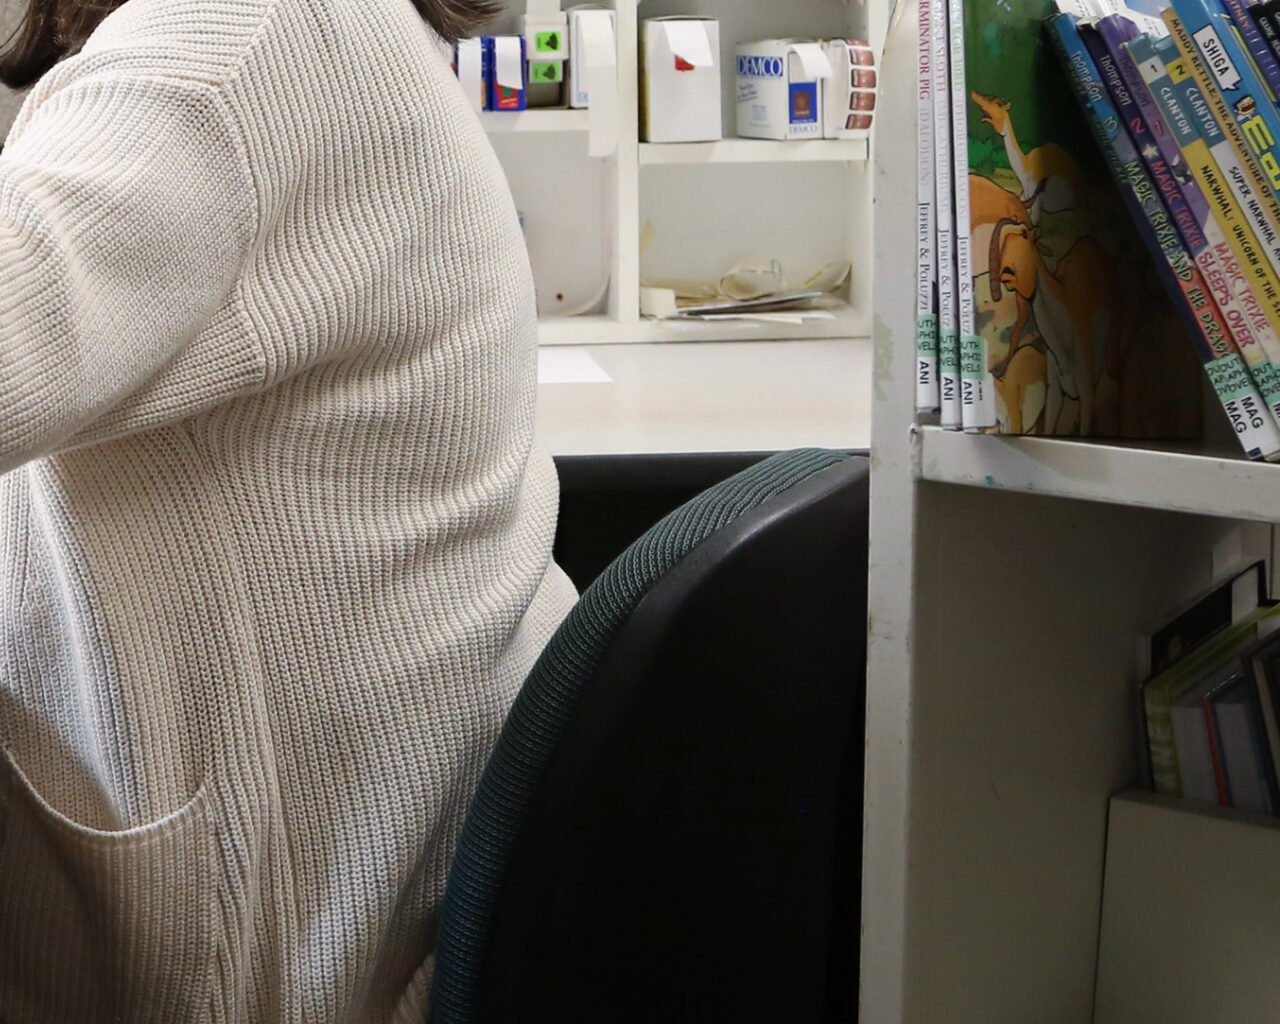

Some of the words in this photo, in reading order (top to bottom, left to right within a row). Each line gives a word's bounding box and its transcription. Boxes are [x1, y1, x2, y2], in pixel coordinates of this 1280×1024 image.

[737, 56, 782, 76] DEMCO
[1202, 38, 1231, 77] SHIGA
[919, 78, 931, 101] PIG
[1169, 18, 1196, 55] MADDY
[1214, 98, 1231, 122] THE
[1225, 121, 1263, 185] ADVENTURE
[1260, 184, 1274, 199] OF
[1175, 64, 1186, 76] 2
[1186, 86, 1220, 137] CLANTON
[1228, 165, 1253, 199] SUPER
[1247, 199, 1277, 246] NARWHAL
[1071, 50, 1103, 103] Thompson
[1104, 114, 1118, 133] 3
[1124, 159, 1157, 207] MAGIC
[1150, 207, 1178, 252] TRIXIE
[1168, 250, 1193, 282] AND
[1186, 284, 1210, 310] THE
[1150, 63, 1159, 74] 1
[1160, 86, 1193, 136] CLANTON
[1232, 224, 1260, 266] UNICORN
[1255, 267, 1266, 279] OF
[1262, 280, 1277, 298] THE
[1099, 55, 1132, 106] Thompson
[1131, 117, 1145, 134] 2
[1150, 160, 1182, 205] MAGIC
[1175, 205, 1204, 249] TRIXIE
[1196, 250, 1234, 307] SLEEPS
[1226, 309, 1256, 349] OVER
[918, 202, 930, 243] JEFFREY
[919, 247, 930, 259] &
[938, 228, 949, 269] JEFFREY
[957, 236, 969, 277] JEFFREY
[941, 275, 950, 286] &
[960, 282, 970, 294] &
[1213, 241, 1246, 289] MAGIC
[1238, 287, 1271, 333] TRIXIE
[919, 360, 929, 385] ANI
[943, 377, 954, 401] ANI
[963, 381, 974, 405] ANI
[1224, 400, 1248, 434] MAG
[1240, 396, 1264, 429] MAG
